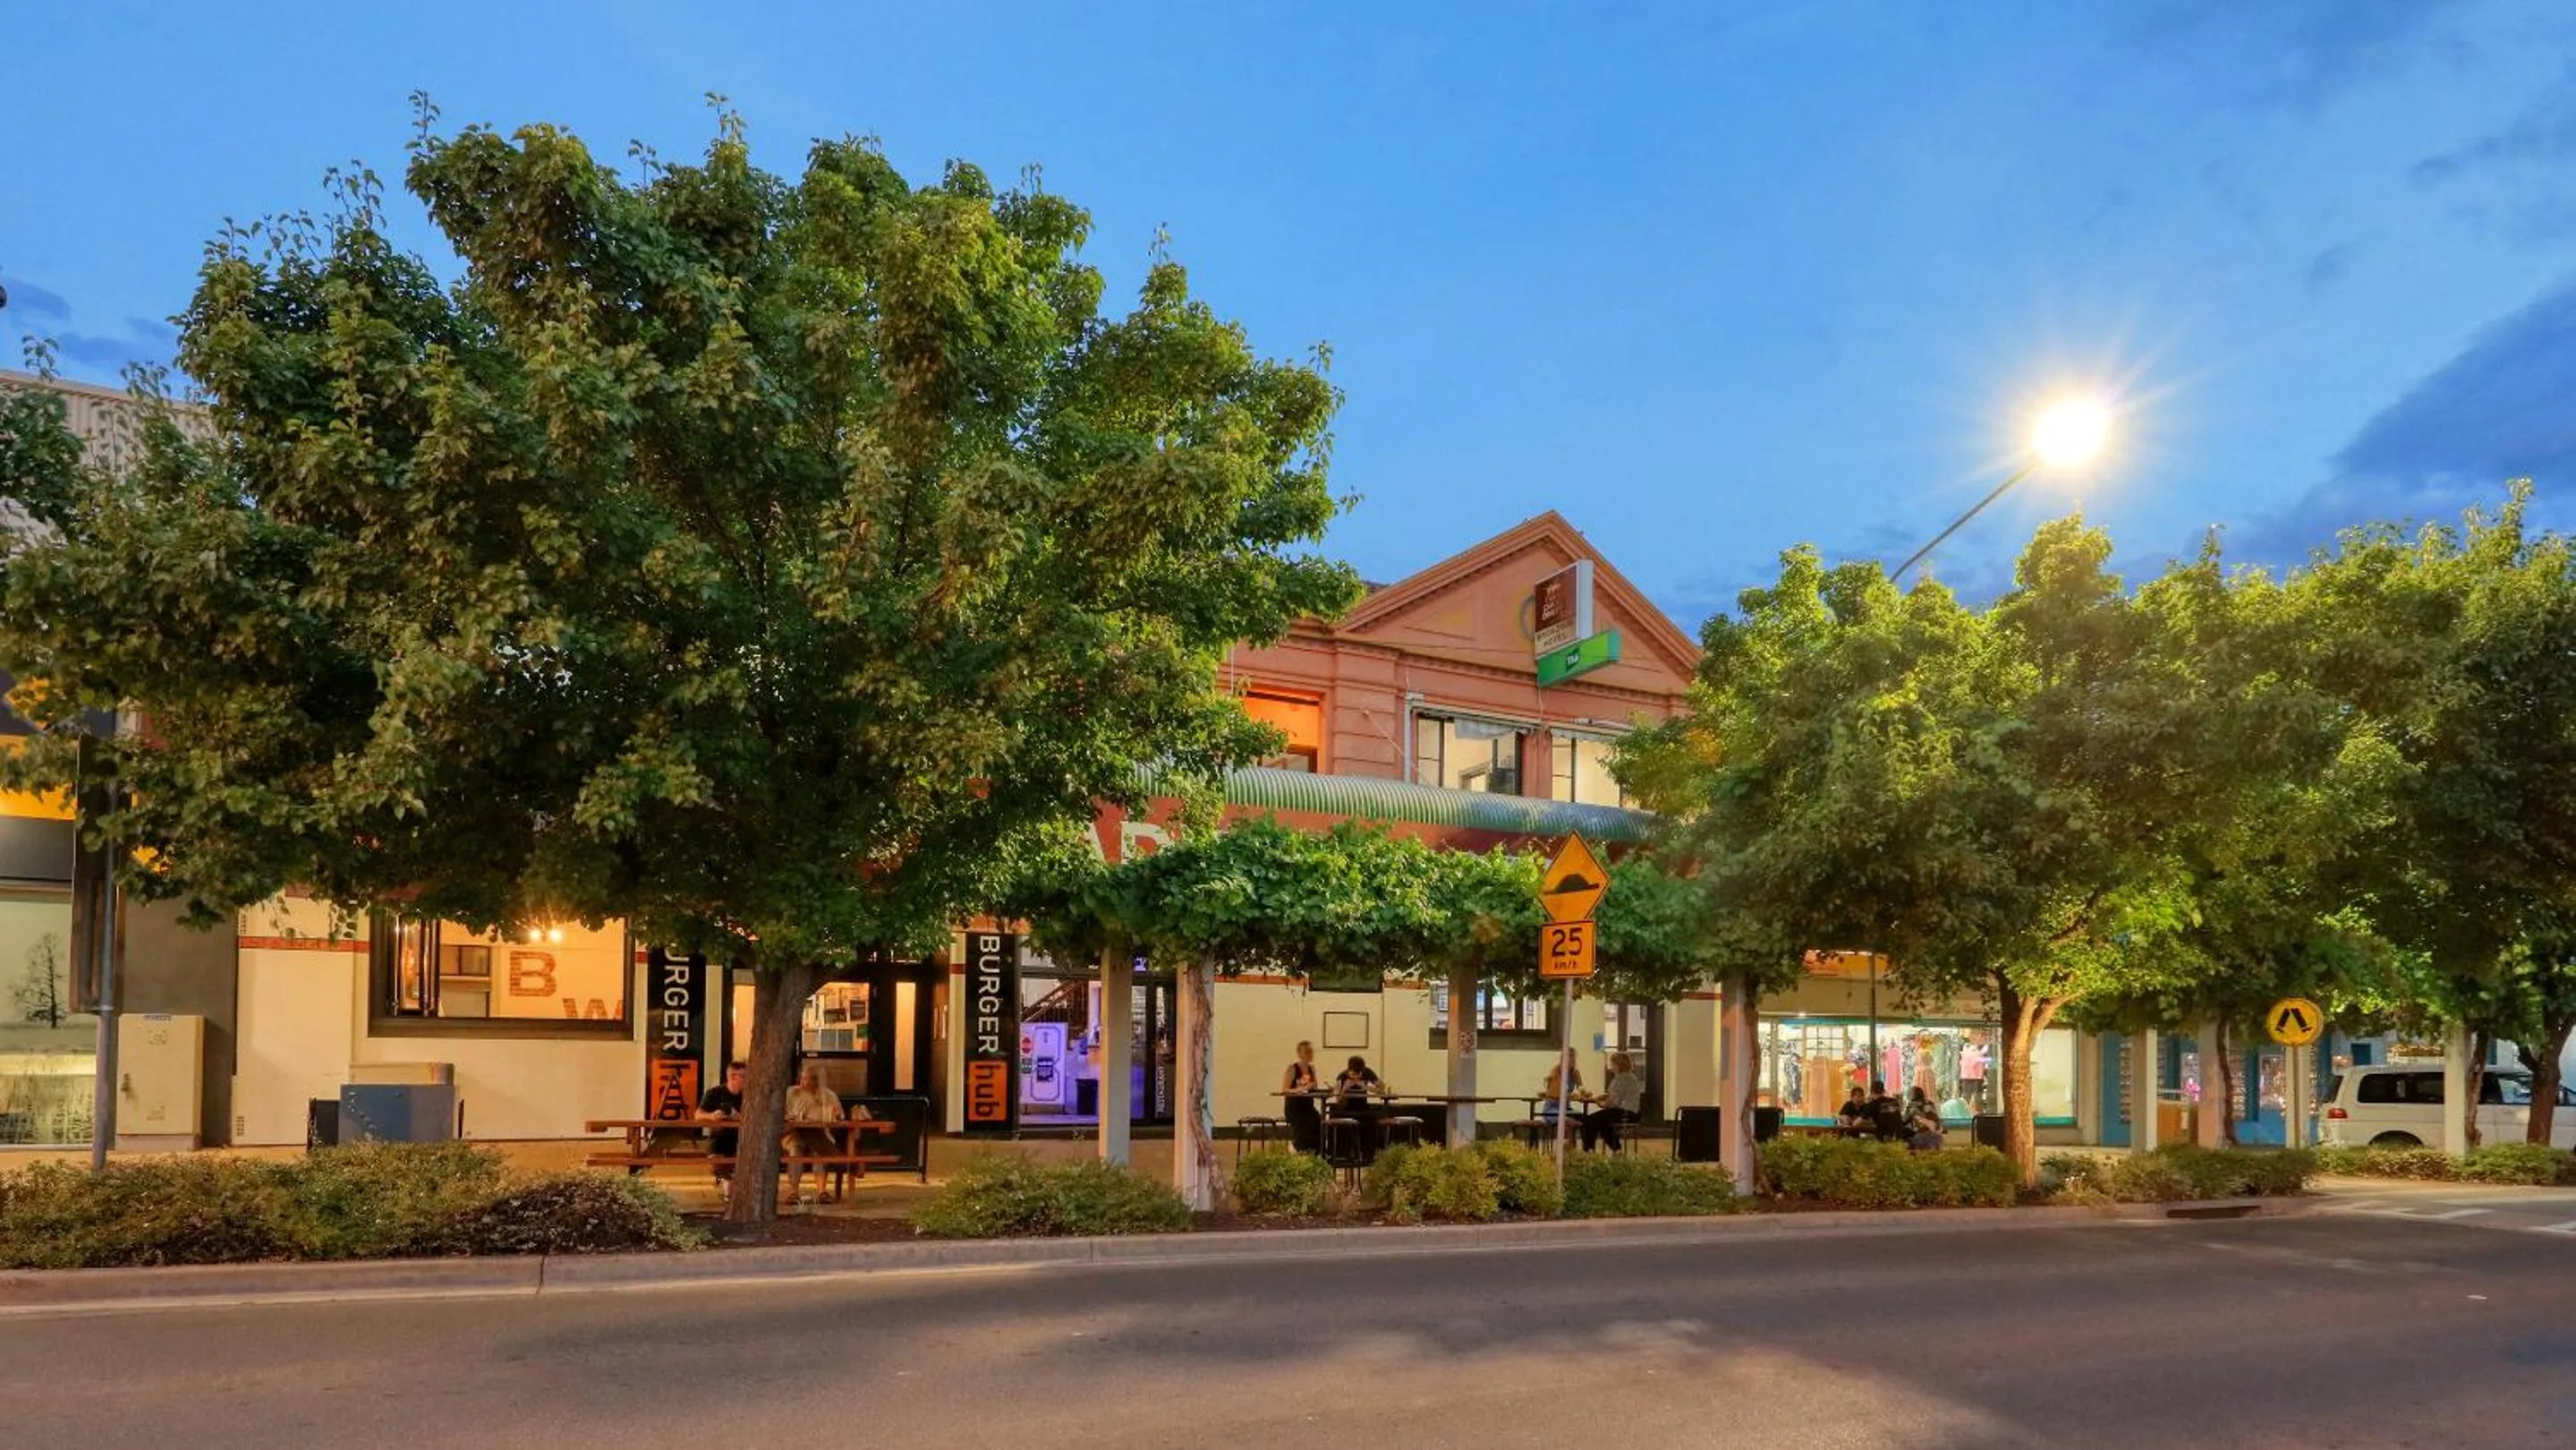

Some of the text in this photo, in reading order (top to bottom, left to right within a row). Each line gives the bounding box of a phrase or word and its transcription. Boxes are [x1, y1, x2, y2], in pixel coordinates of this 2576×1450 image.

[509, 951, 557, 997] B
[1552, 927, 1582, 956] 25
[663, 943, 690, 1051] URGER
[974, 935, 1000, 1118] BURGER hub
